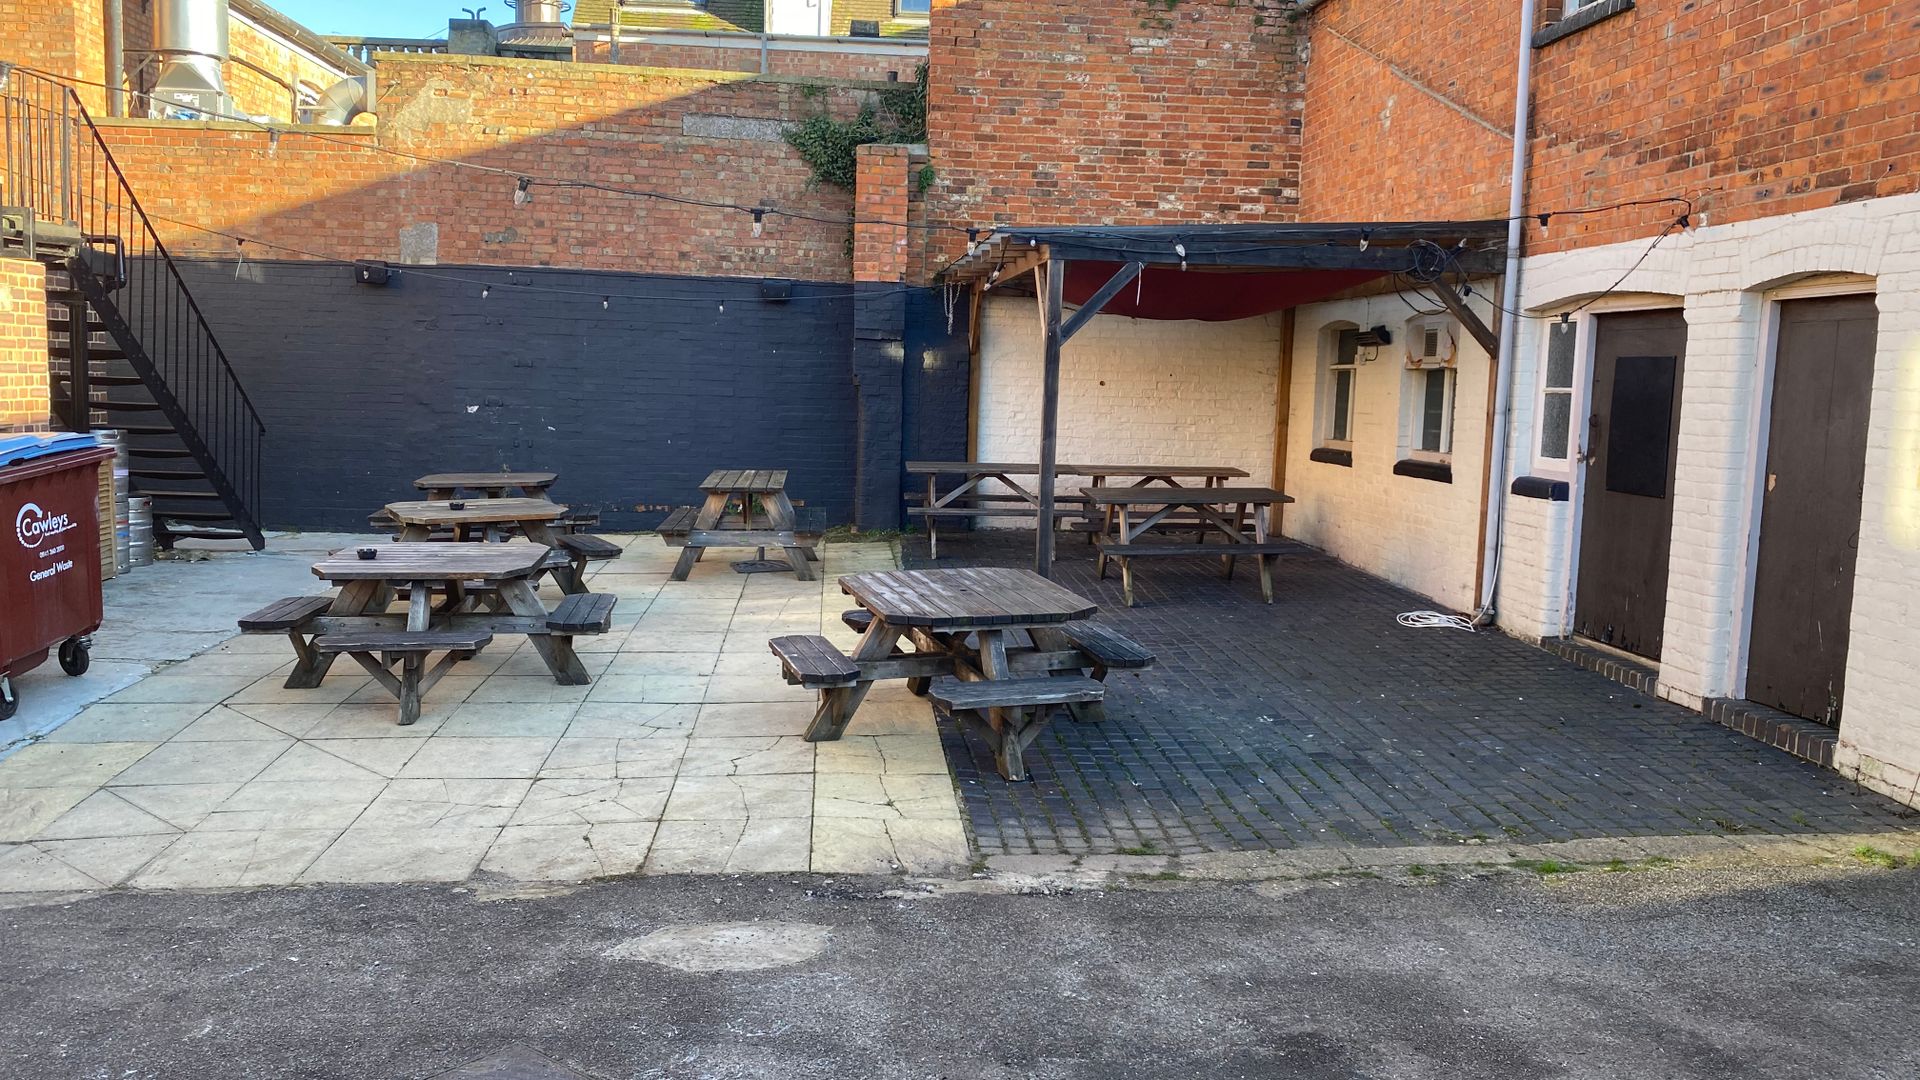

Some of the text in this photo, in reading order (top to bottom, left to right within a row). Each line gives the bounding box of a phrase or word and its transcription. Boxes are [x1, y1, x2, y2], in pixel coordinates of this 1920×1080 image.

[22, 511, 69, 537] Cawleys
[29, 560, 73, 582] General Waste
